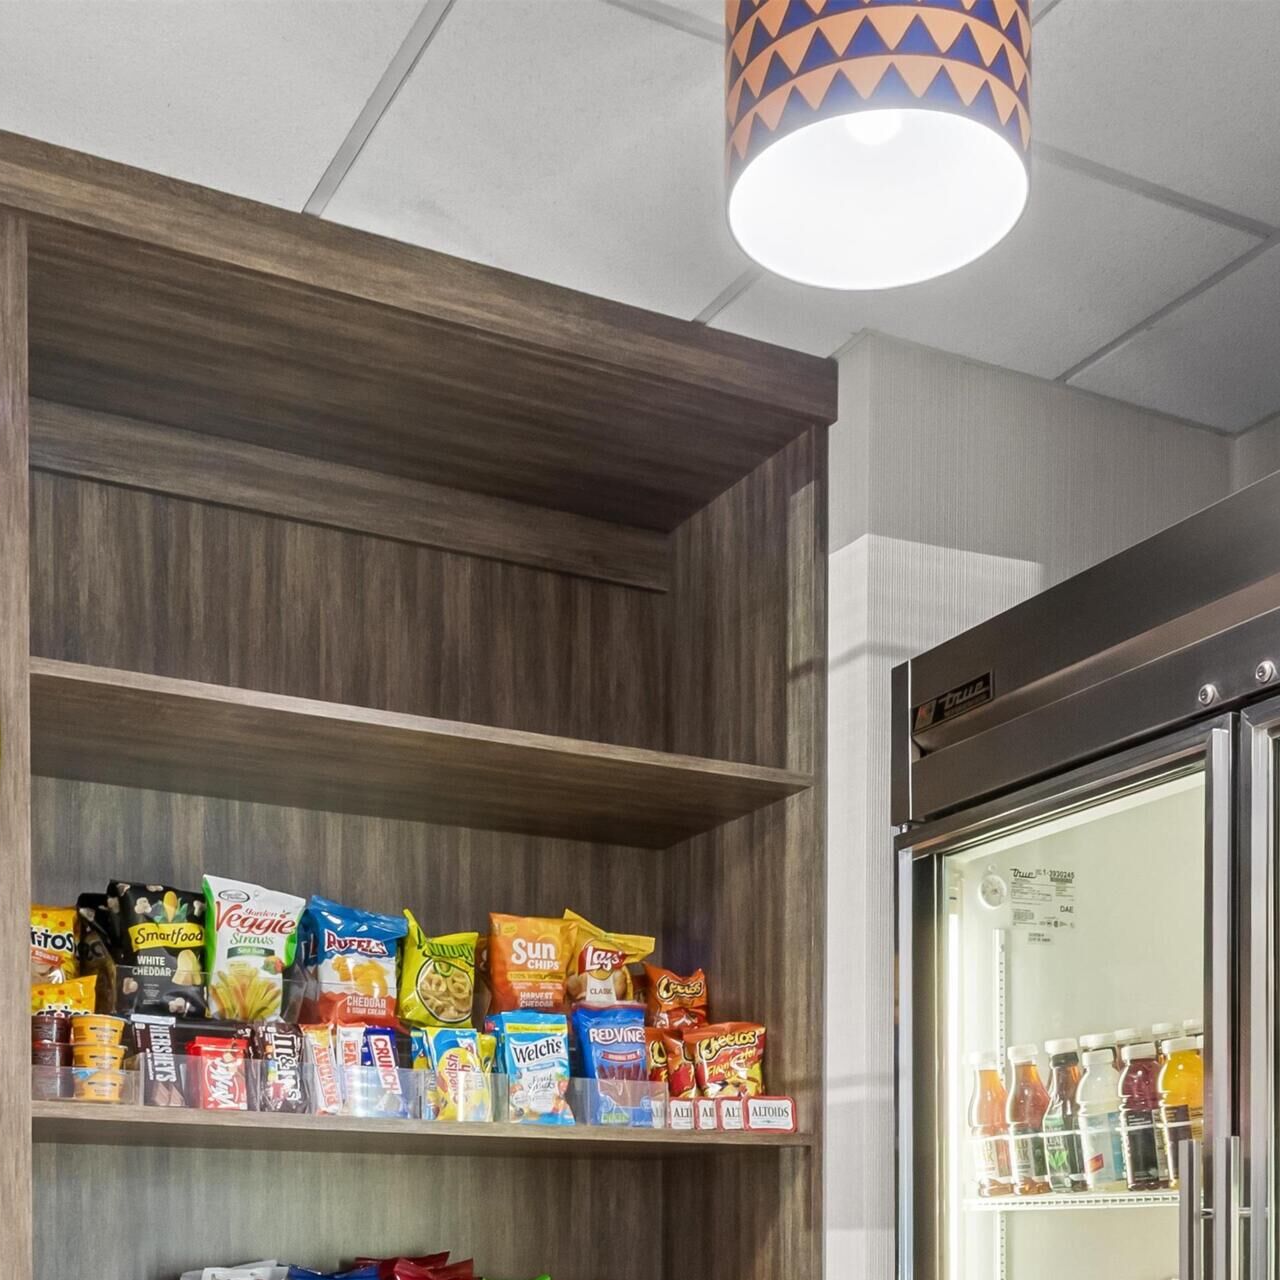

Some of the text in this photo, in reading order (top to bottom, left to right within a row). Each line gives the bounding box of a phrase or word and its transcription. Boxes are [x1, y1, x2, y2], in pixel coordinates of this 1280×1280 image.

[216, 900, 296, 934] Veggie
[134, 926, 203, 945] Smartfood
[229, 933, 275, 945] Straws
[325, 930, 388, 955] RUFFLES
[511, 939, 556, 965] Sun
[586, 947, 622, 971] Lay's
[137, 956, 165, 966] WHITE
[527, 960, 559, 970] CHIPS
[132, 967, 171, 976] CHEDDAR
[346, 996, 386, 1008] CHEDDAR
[520, 992, 553, 1000] HARVEST
[589, 1028, 645, 1043] RED VINES
[514, 1038, 562, 1064] Welch's
[699, 1030, 757, 1060] Cheetos
[373, 1038, 398, 1093] CRUNCH
[752, 1106, 789, 1118] ALTOIDS
